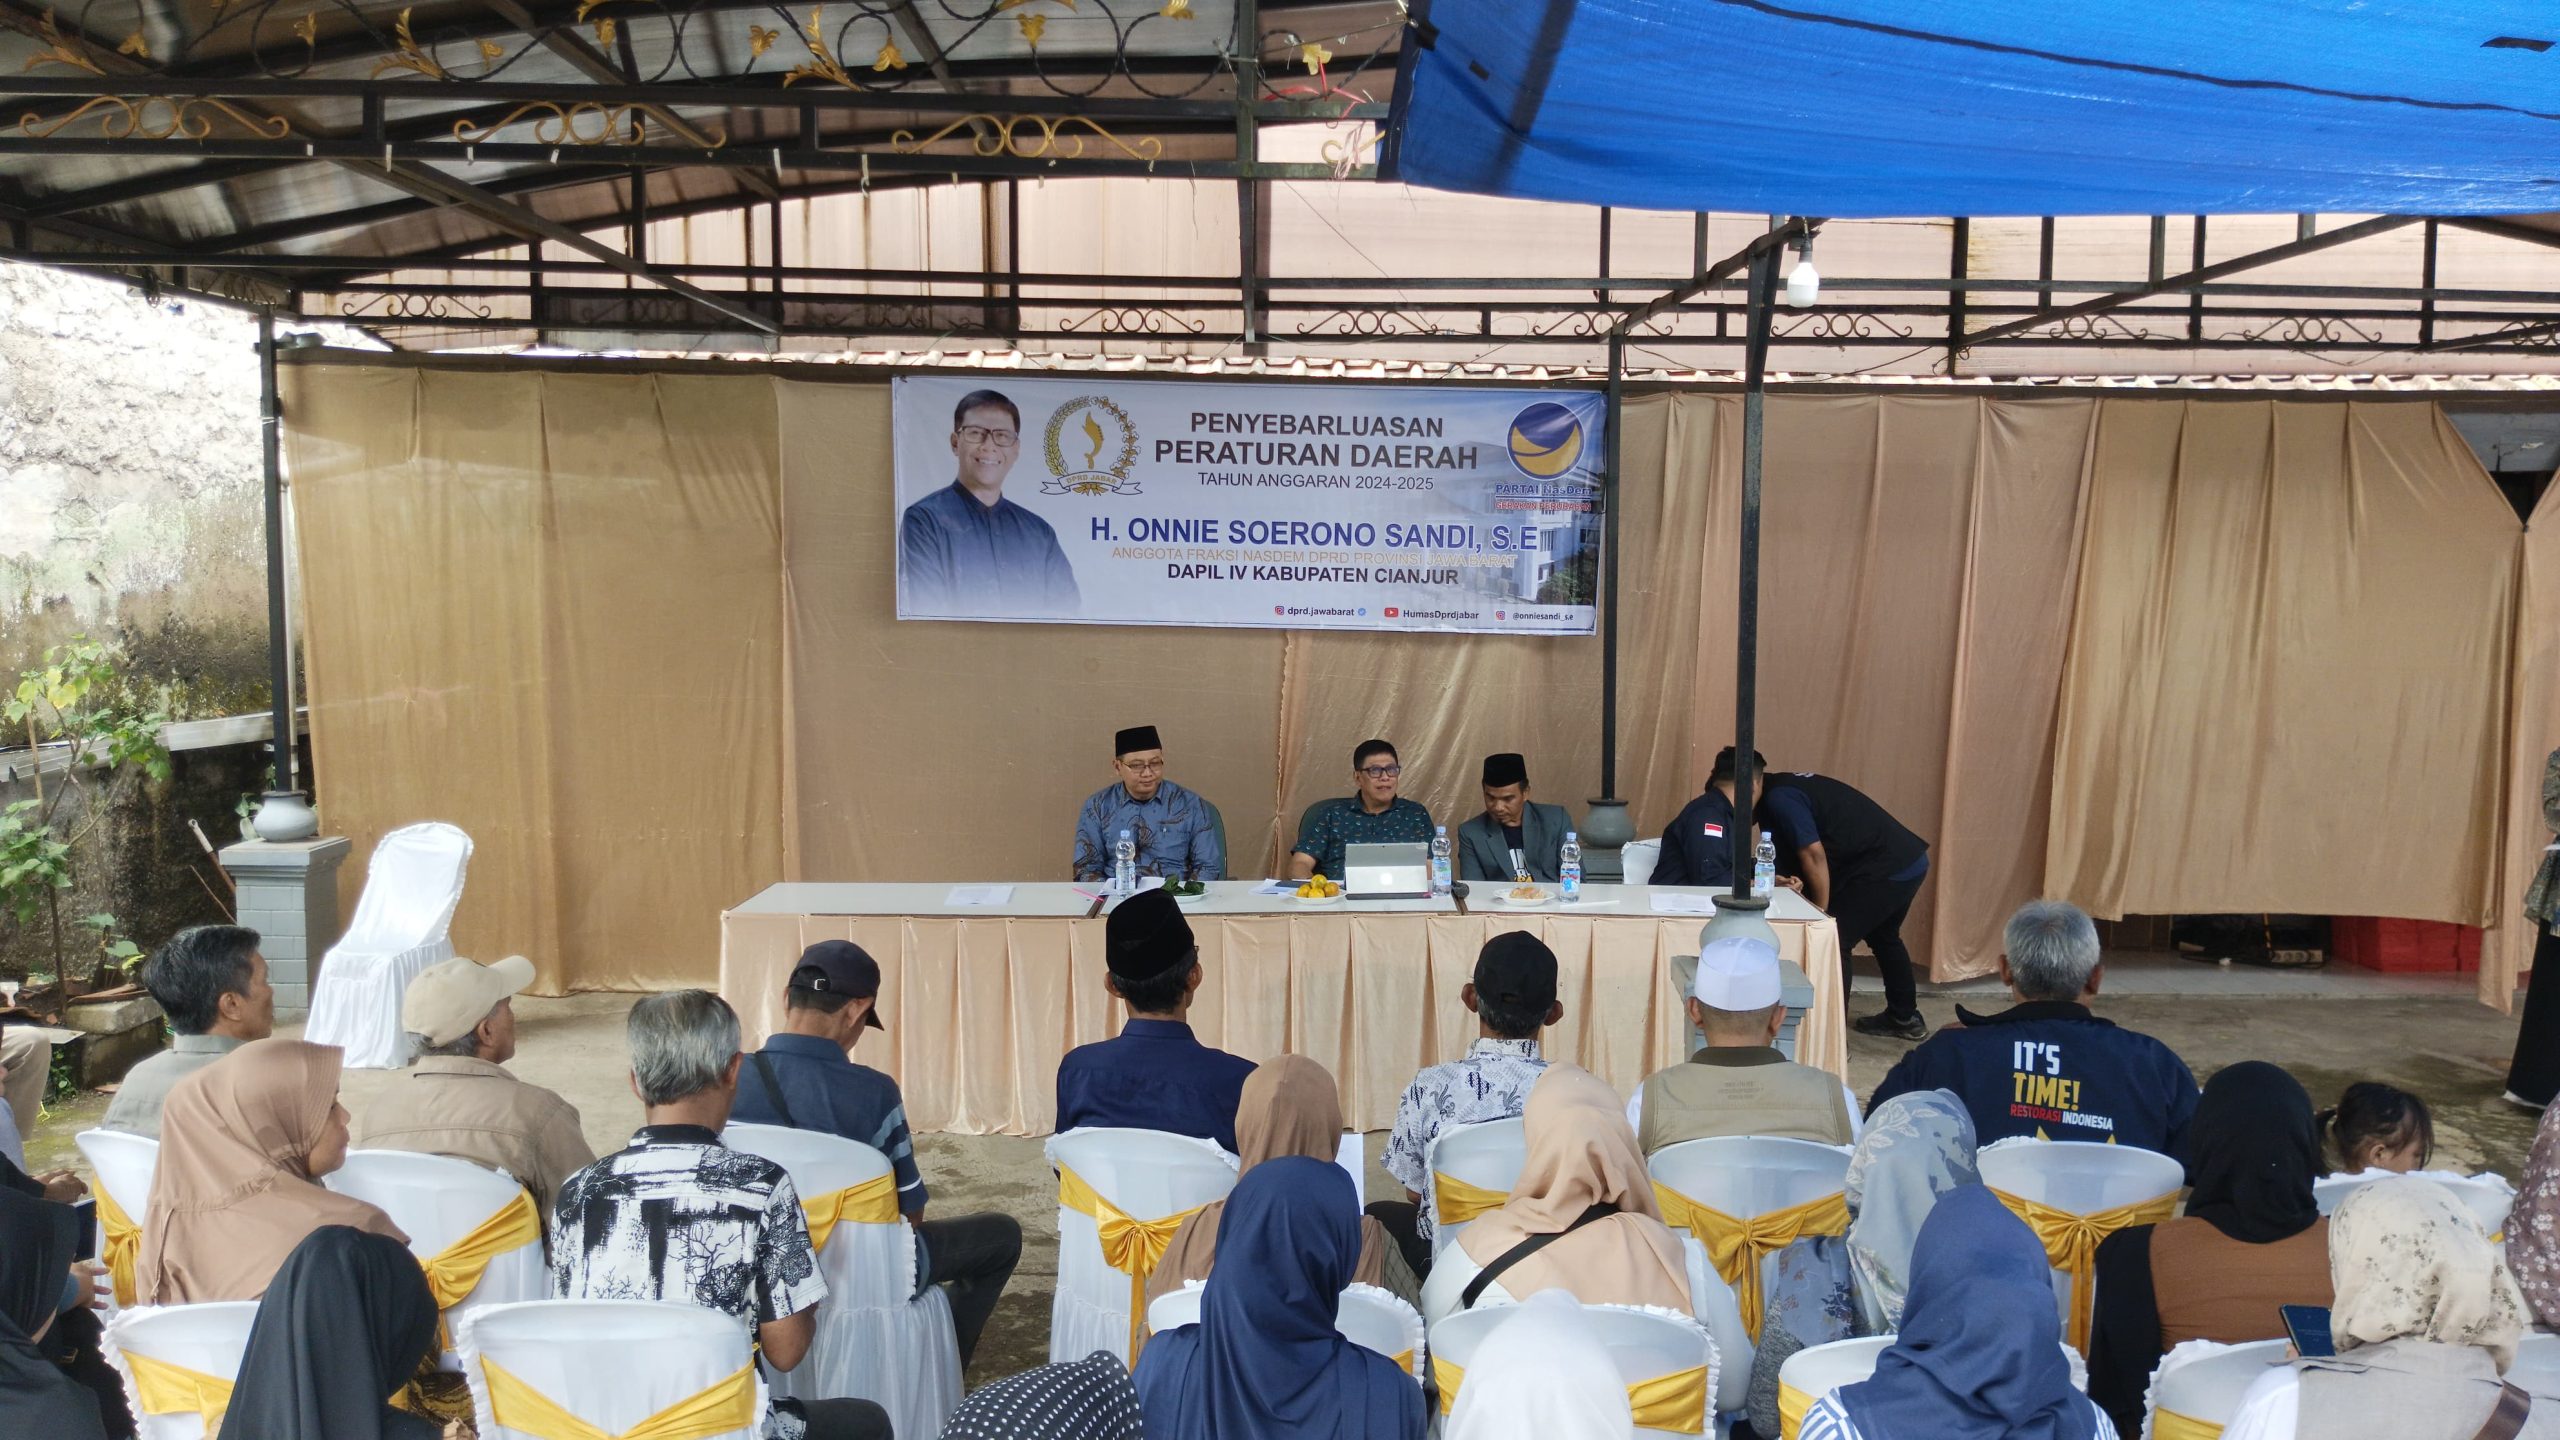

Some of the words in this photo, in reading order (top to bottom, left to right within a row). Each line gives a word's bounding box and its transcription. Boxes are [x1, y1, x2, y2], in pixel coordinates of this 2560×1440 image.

[1191, 412, 1443, 438] PENYEBARLUASAN
[1155, 440, 1340, 467] PERATURAN
[1351, 444, 1477, 469] DAERAH
[1066, 474, 1088, 484] DPRD
[1198, 472, 1253, 486] TAHUN
[1257, 473, 1350, 489] ANGGARAN
[1355, 475, 1434, 490] 2024-2025
[1495, 484, 1539, 494] PARTAI
[1543, 486, 1592, 496] NasDem
[1091, 517, 1118, 541] H.
[1128, 518, 1219, 543] ONNIE
[1228, 520, 1376, 547] SOERONO
[1385, 523, 1482, 553] SANDI,
[1491, 525, 1538, 550] S.E
[1112, 547, 1183, 560] ANGGOTA
[1187, 549, 1238, 561] FRAKSI
[1243, 550, 1304, 562] NASDEM
[1309, 551, 1349, 563] DPRD
[1354, 553, 1423, 565] PROVINSI
[1427, 554, 1467, 567] JAWA
[1468, 554, 1517, 568] BARAT
[1168, 564, 1224, 579] DAPIL
[1229, 565, 1247, 580] IV
[1253, 566, 1368, 583] KABUPATEN
[1374, 568, 1459, 584] CIANJUR
[1287, 606, 1354, 616] dprd.jawabarat
[1403, 609, 1479, 620] HumasDprdjabar
[2014, 1041, 2060, 1075] IT'S
[2013, 1072, 2080, 1111] TIME!
[2010, 1104, 2060, 1122] RESTORASI
[2062, 1111, 2113, 1131] INDONESIA
